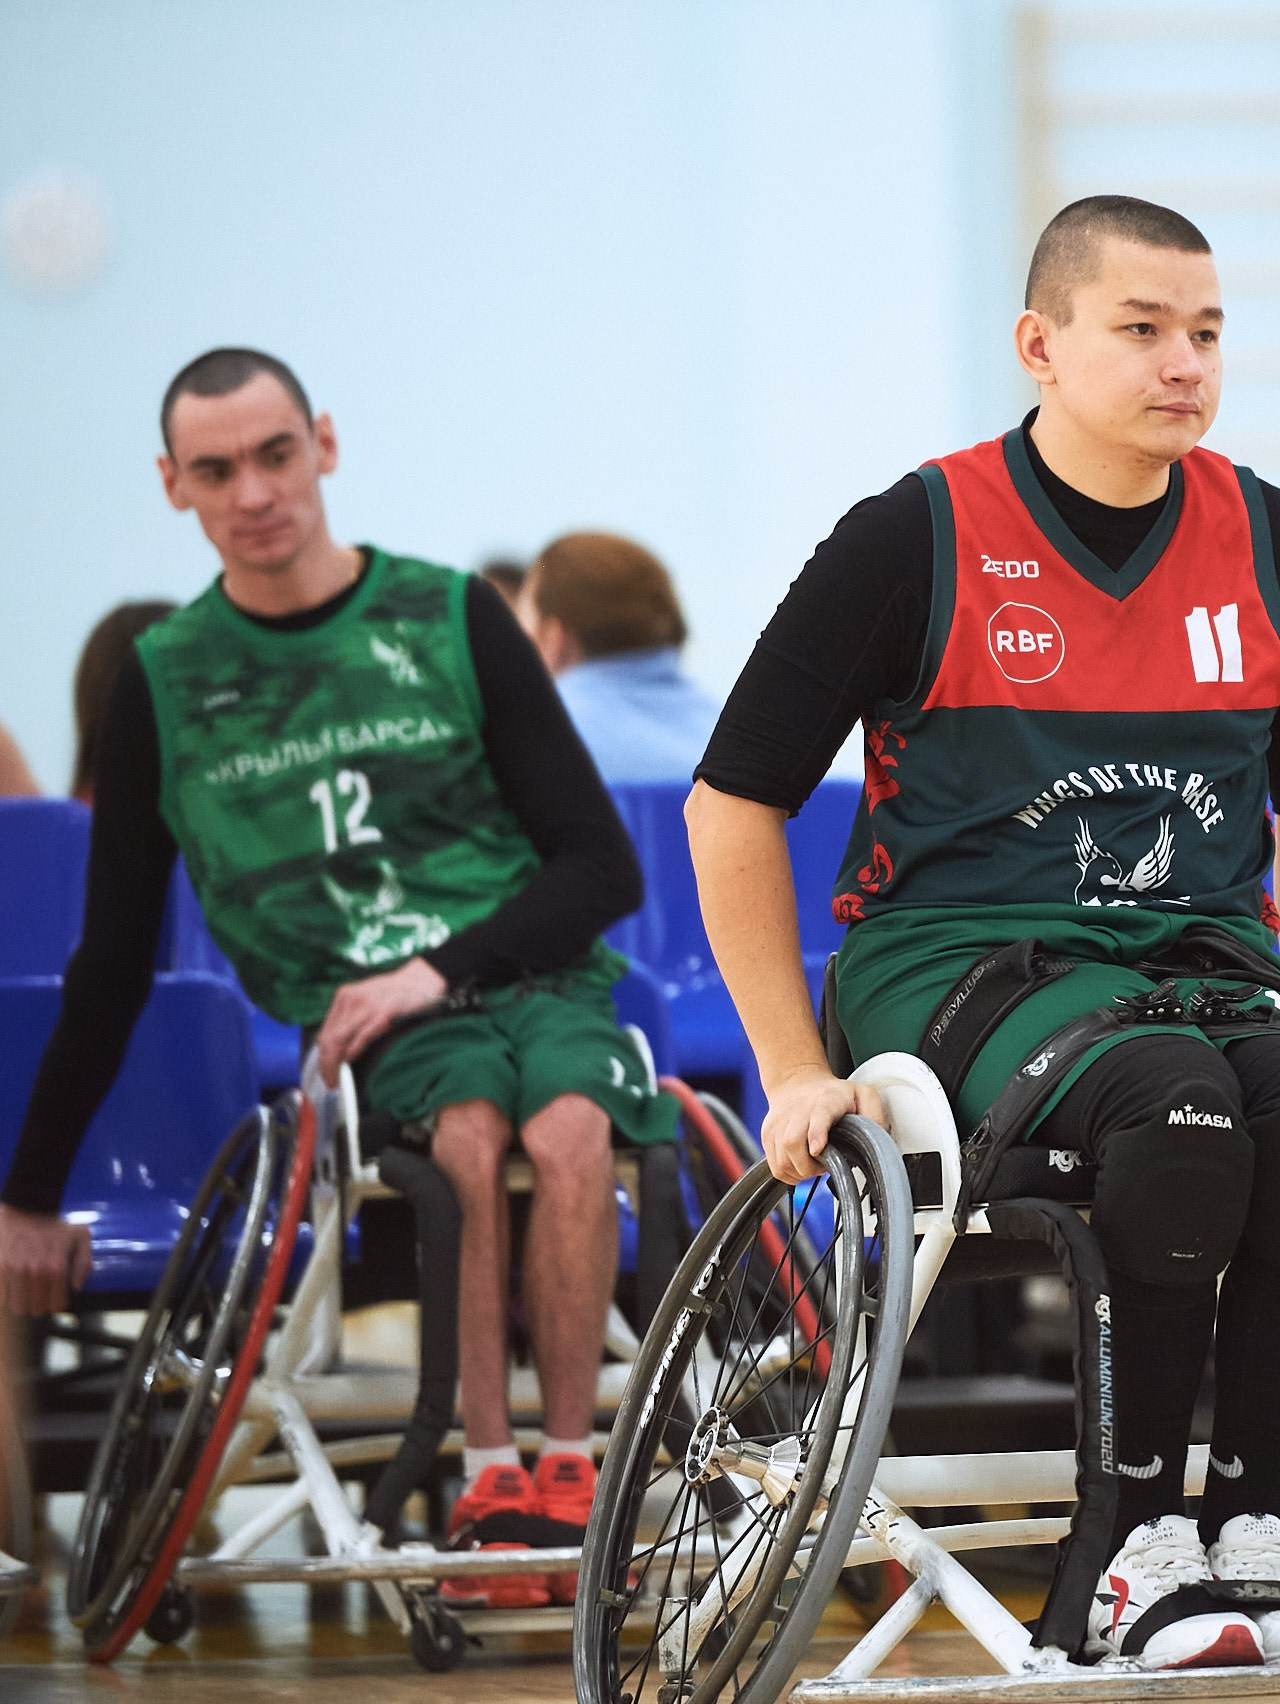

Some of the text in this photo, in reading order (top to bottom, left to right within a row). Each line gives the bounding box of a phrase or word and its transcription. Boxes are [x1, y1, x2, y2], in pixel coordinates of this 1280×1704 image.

[996, 629, 1054, 654] RBF
[1184, 602, 1245, 683] 11
[1087, 763, 1125, 794] OF
[1125, 763, 1177, 792] THE
[308, 768, 383, 855] 12
